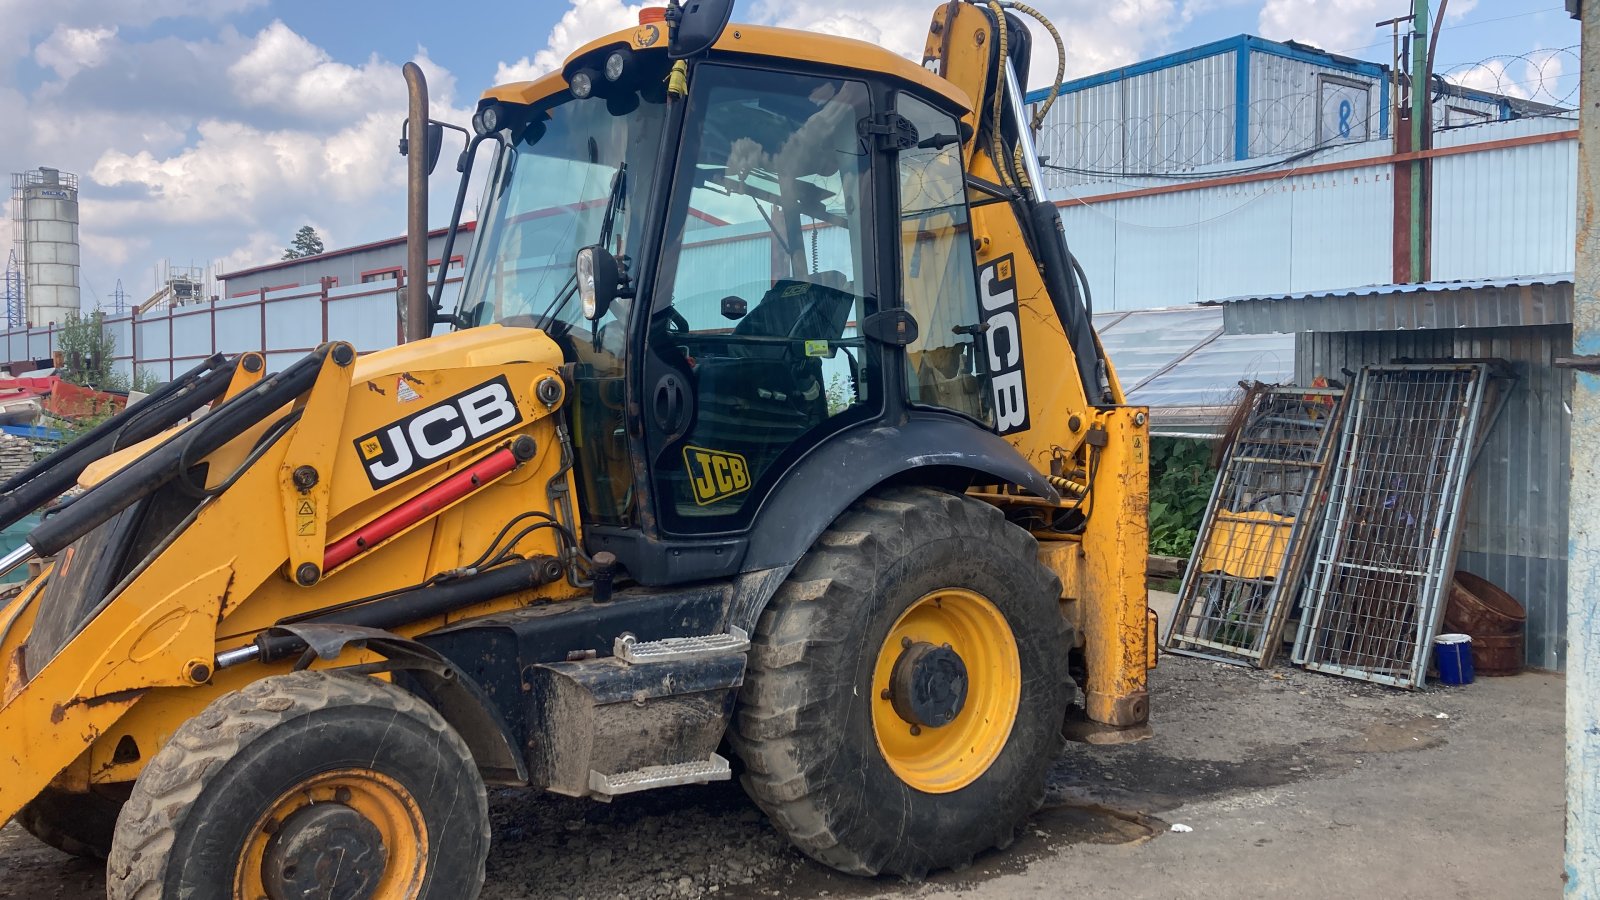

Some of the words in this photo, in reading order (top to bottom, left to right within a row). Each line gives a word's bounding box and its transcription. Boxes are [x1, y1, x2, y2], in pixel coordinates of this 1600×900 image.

[1339, 99, 1351, 138] 8
[980, 265, 1026, 432] JCB
[369, 383, 517, 482] JCB
[695, 452, 746, 499] JCB
